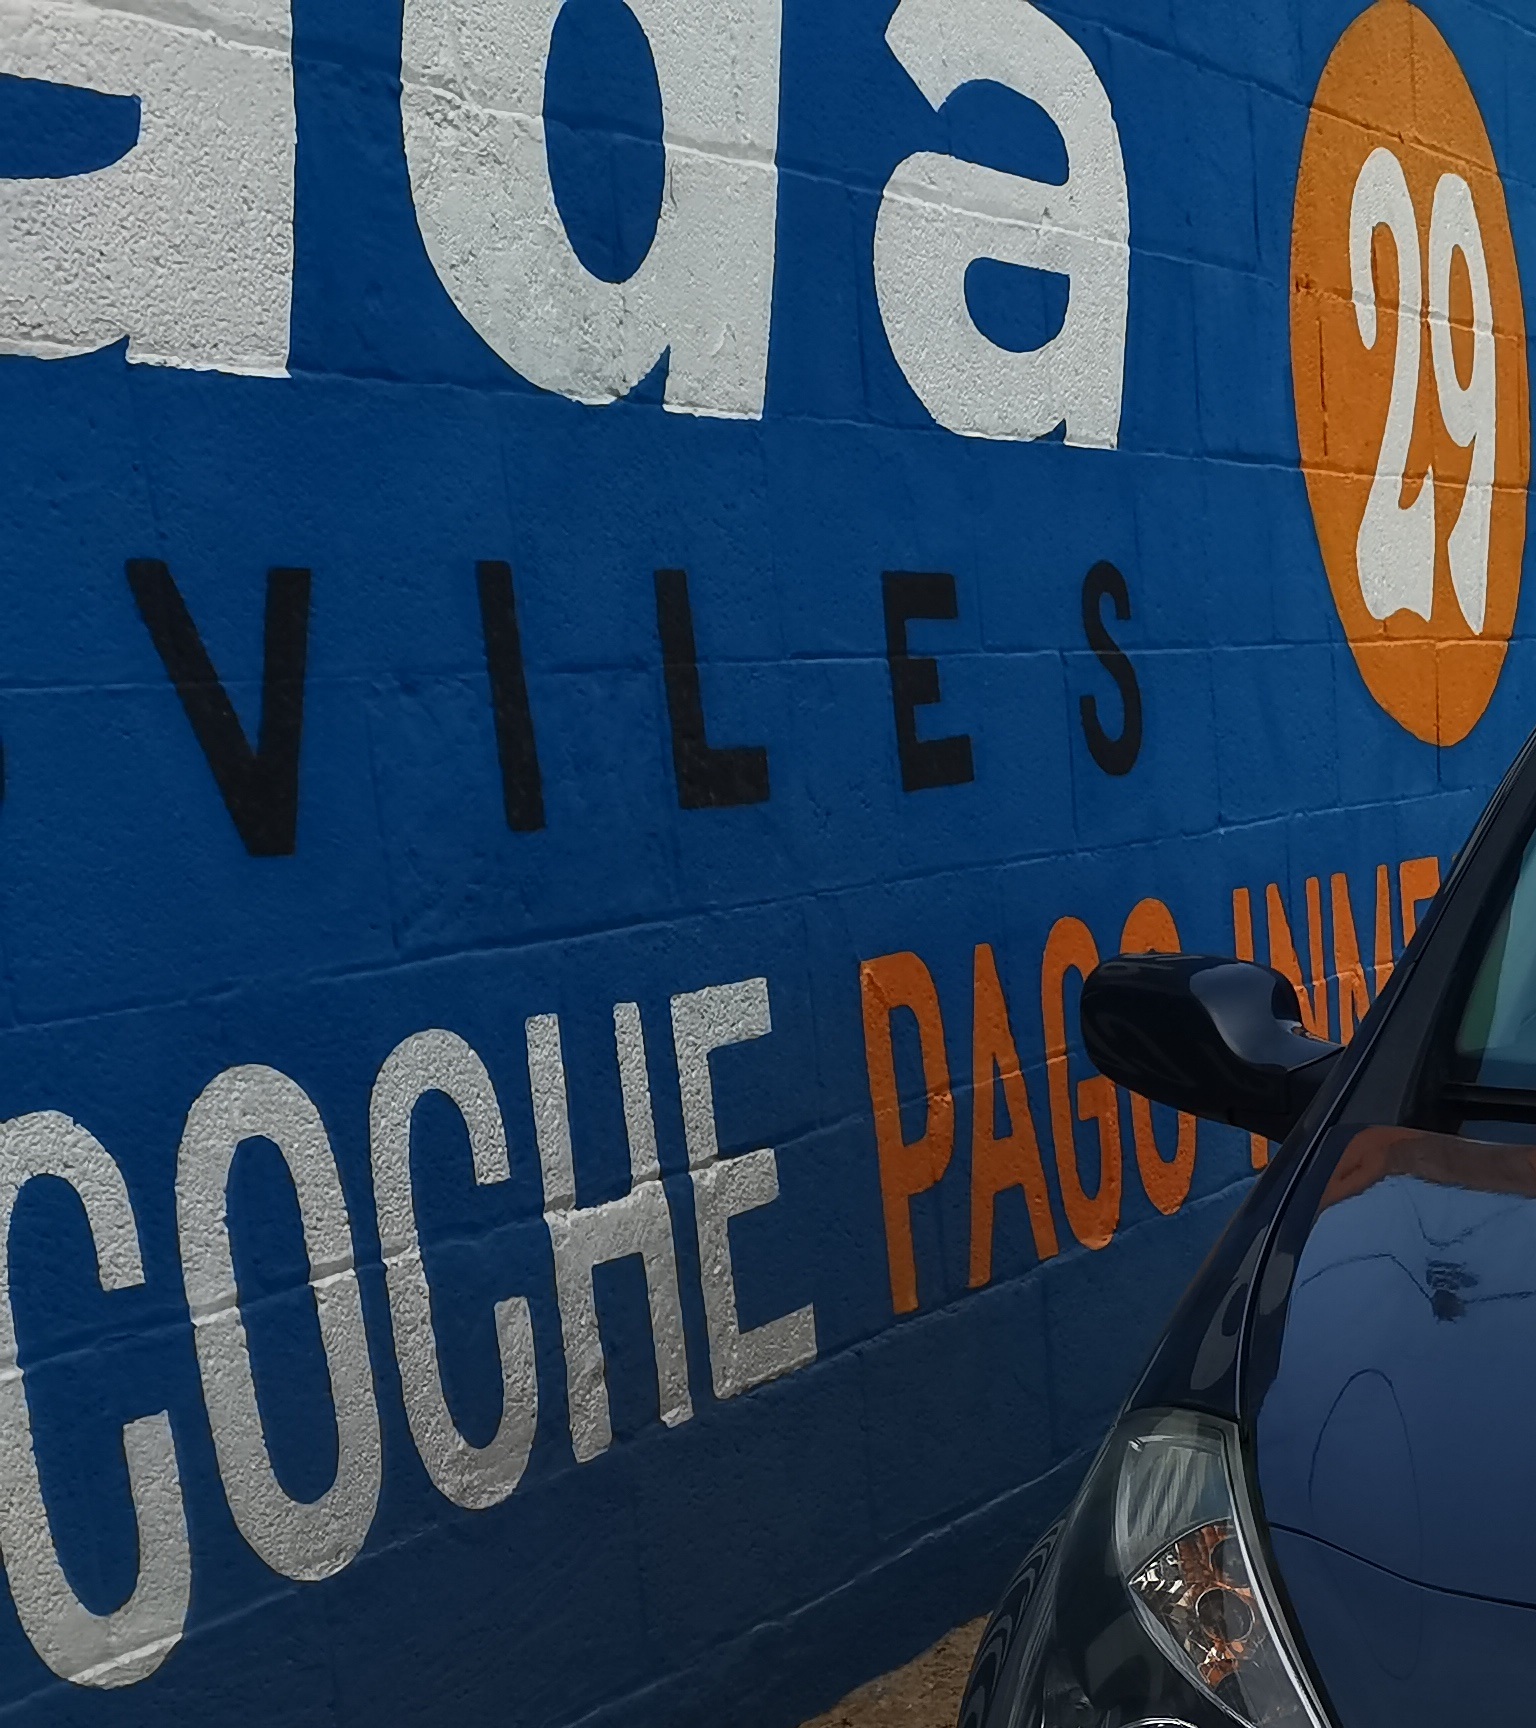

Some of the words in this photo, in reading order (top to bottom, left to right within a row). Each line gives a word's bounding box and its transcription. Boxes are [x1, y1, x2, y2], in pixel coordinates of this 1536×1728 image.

[1349, 147, 1496, 635] 29
[0, 558, 1143, 857] VILES
[0, 976, 818, 1690] COCHE
[859, 897, 1198, 1314] PAGO
